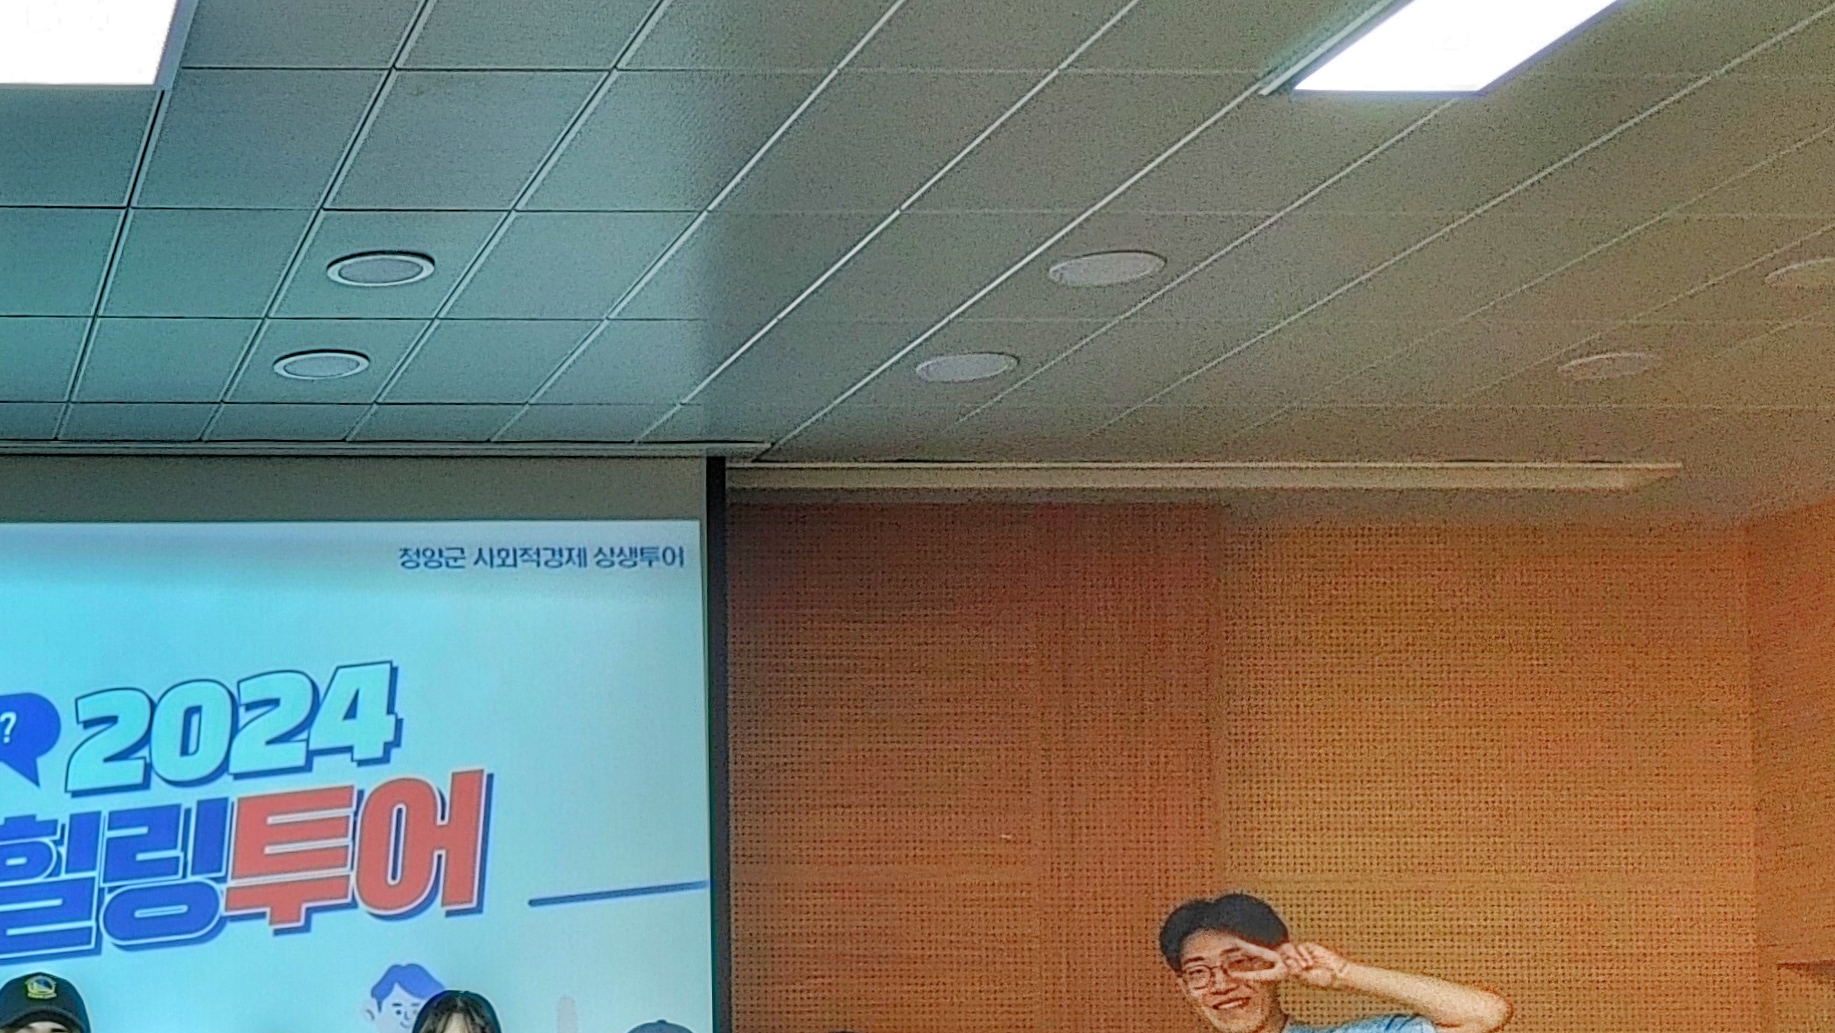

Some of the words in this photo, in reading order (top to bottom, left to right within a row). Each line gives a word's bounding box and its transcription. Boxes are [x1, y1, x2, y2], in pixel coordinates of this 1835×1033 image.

[473, 546, 587, 569] 사회적경제
[593, 546, 684, 569] 상생투어
[65, 661, 401, 796] 2024
